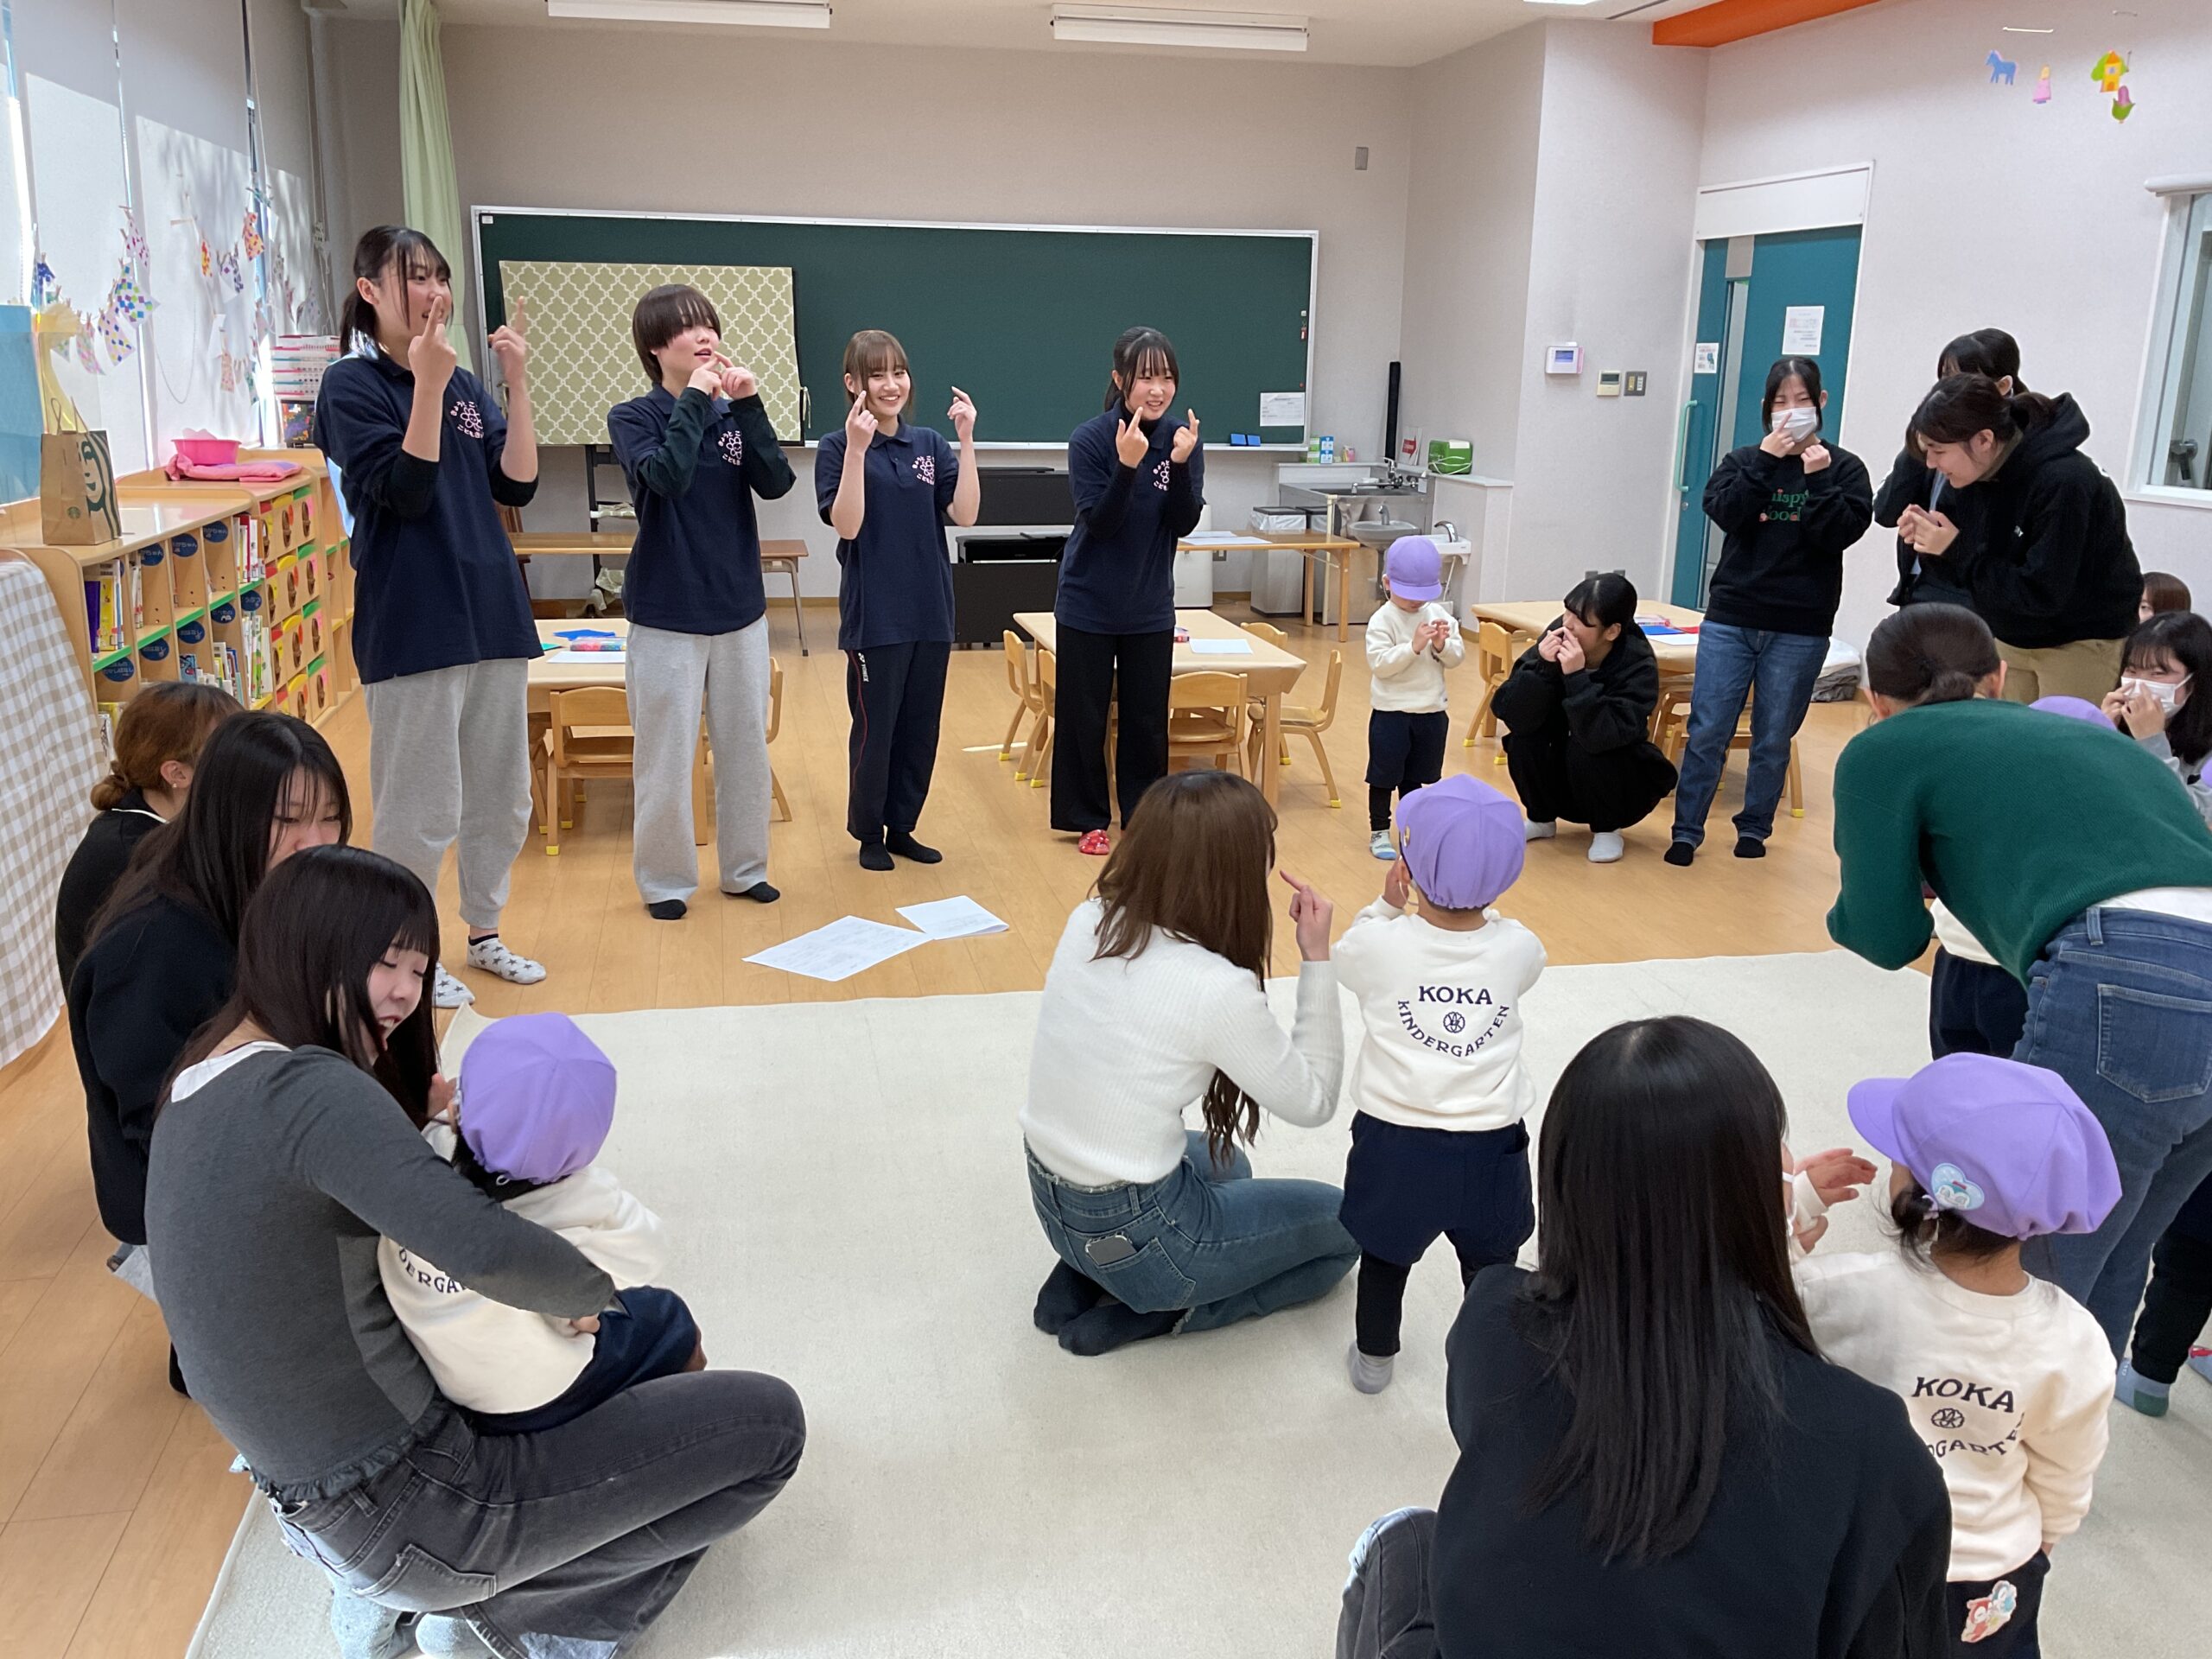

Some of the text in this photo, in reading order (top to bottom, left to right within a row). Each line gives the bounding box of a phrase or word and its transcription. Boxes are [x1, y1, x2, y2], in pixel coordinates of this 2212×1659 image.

[1418, 986, 1493, 1005] KOKA
[1397, 999, 1510, 1058] KINDERGARTEN
[1910, 1376, 2015, 1413] KOKA
